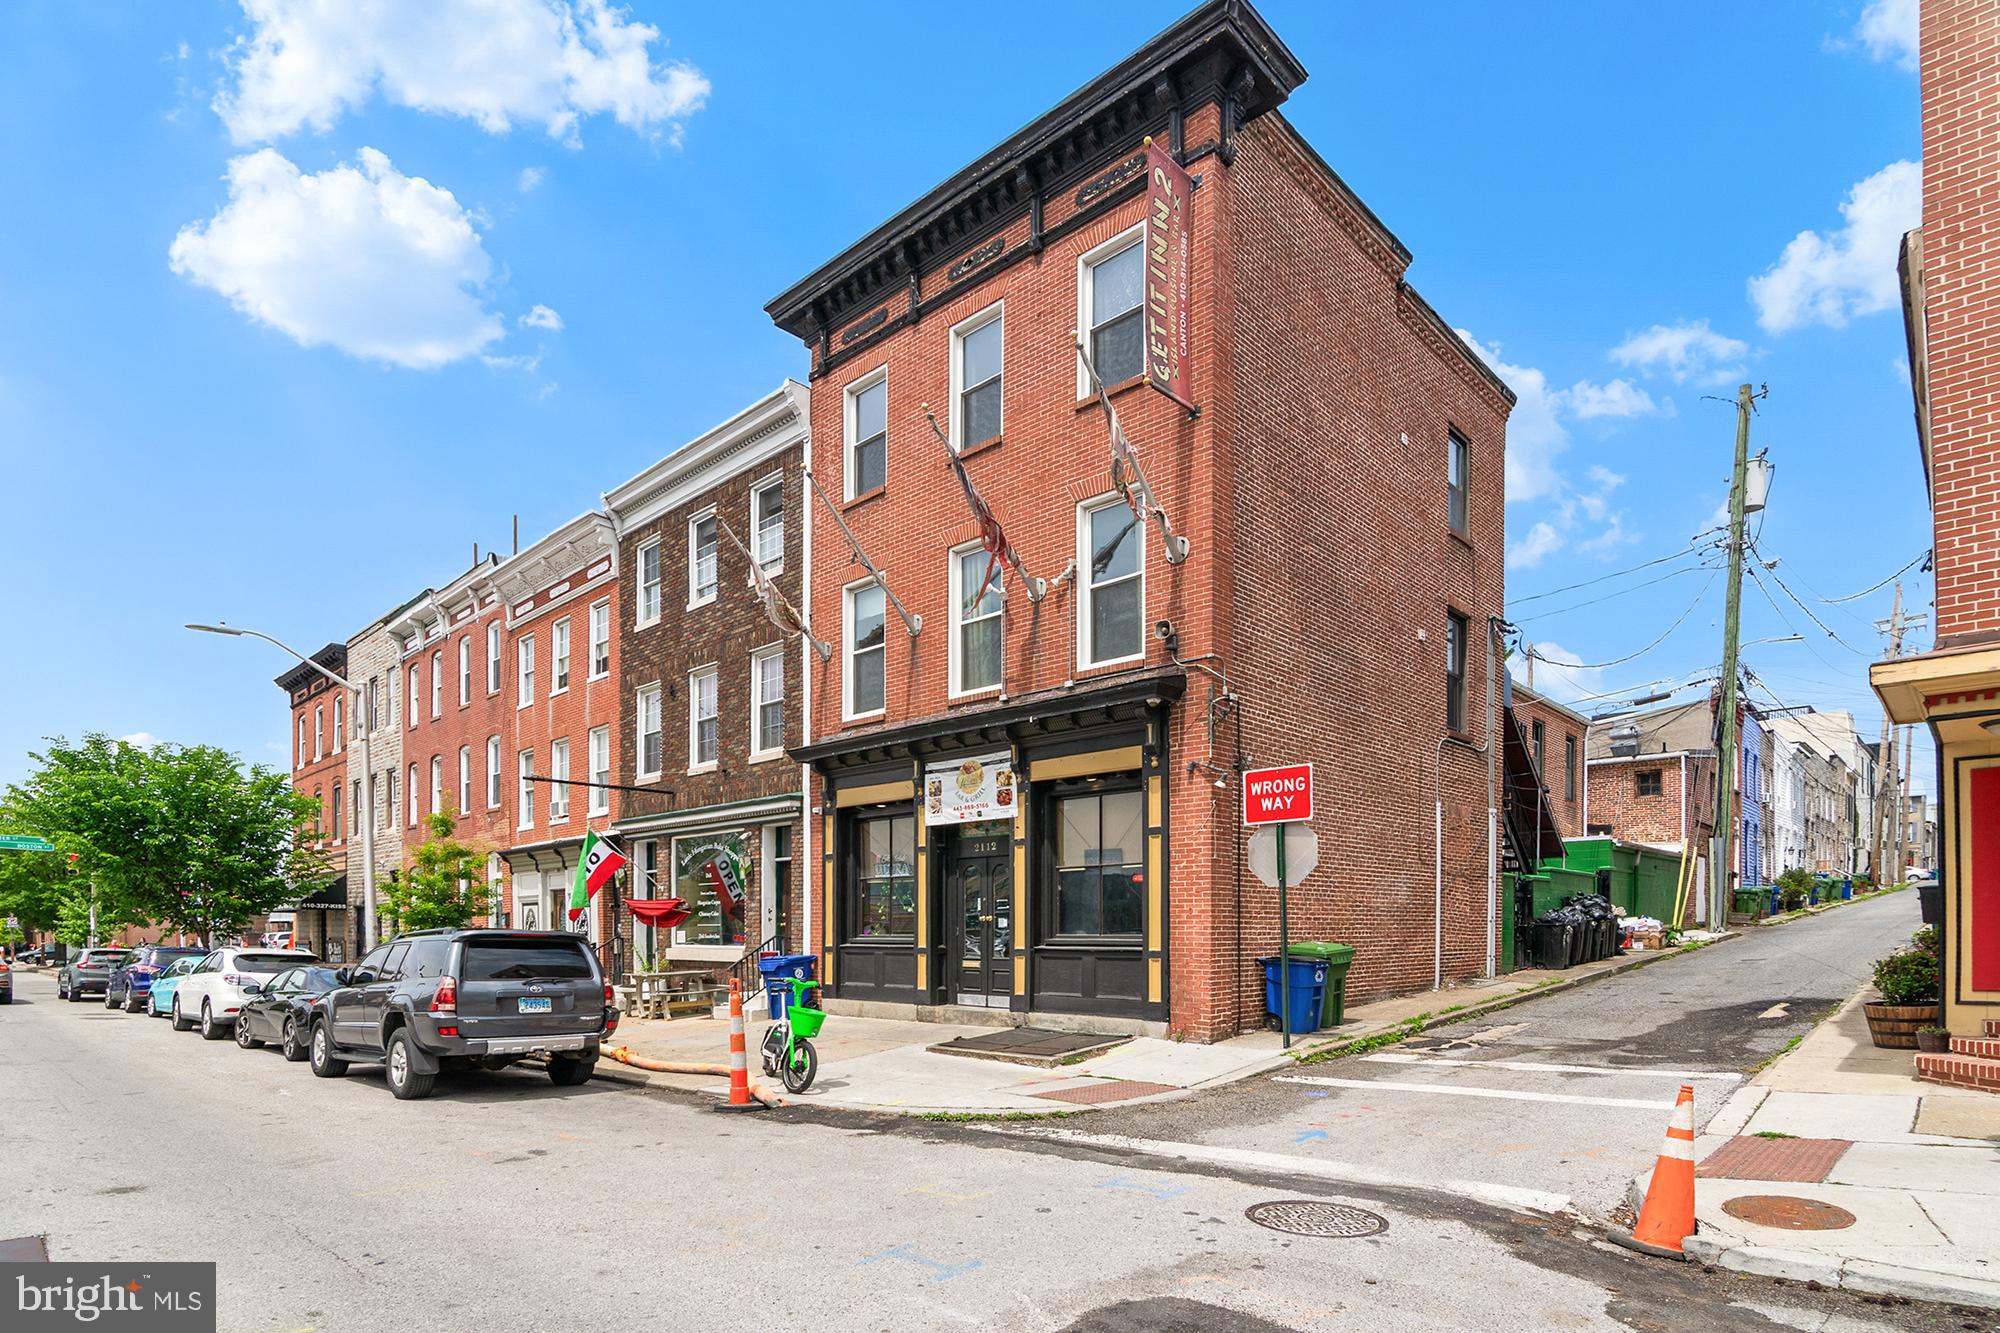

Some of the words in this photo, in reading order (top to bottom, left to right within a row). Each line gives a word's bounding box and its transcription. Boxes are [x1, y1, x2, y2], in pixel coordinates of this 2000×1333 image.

[1154, 166, 1172, 198] 2
[1150, 196, 1171, 283] INN
[1149, 316, 1171, 381] GET
[1250, 776, 1306, 796] WRONG
[1261, 795, 1294, 812] WAY
[974, 841, 997, 852] 2112
